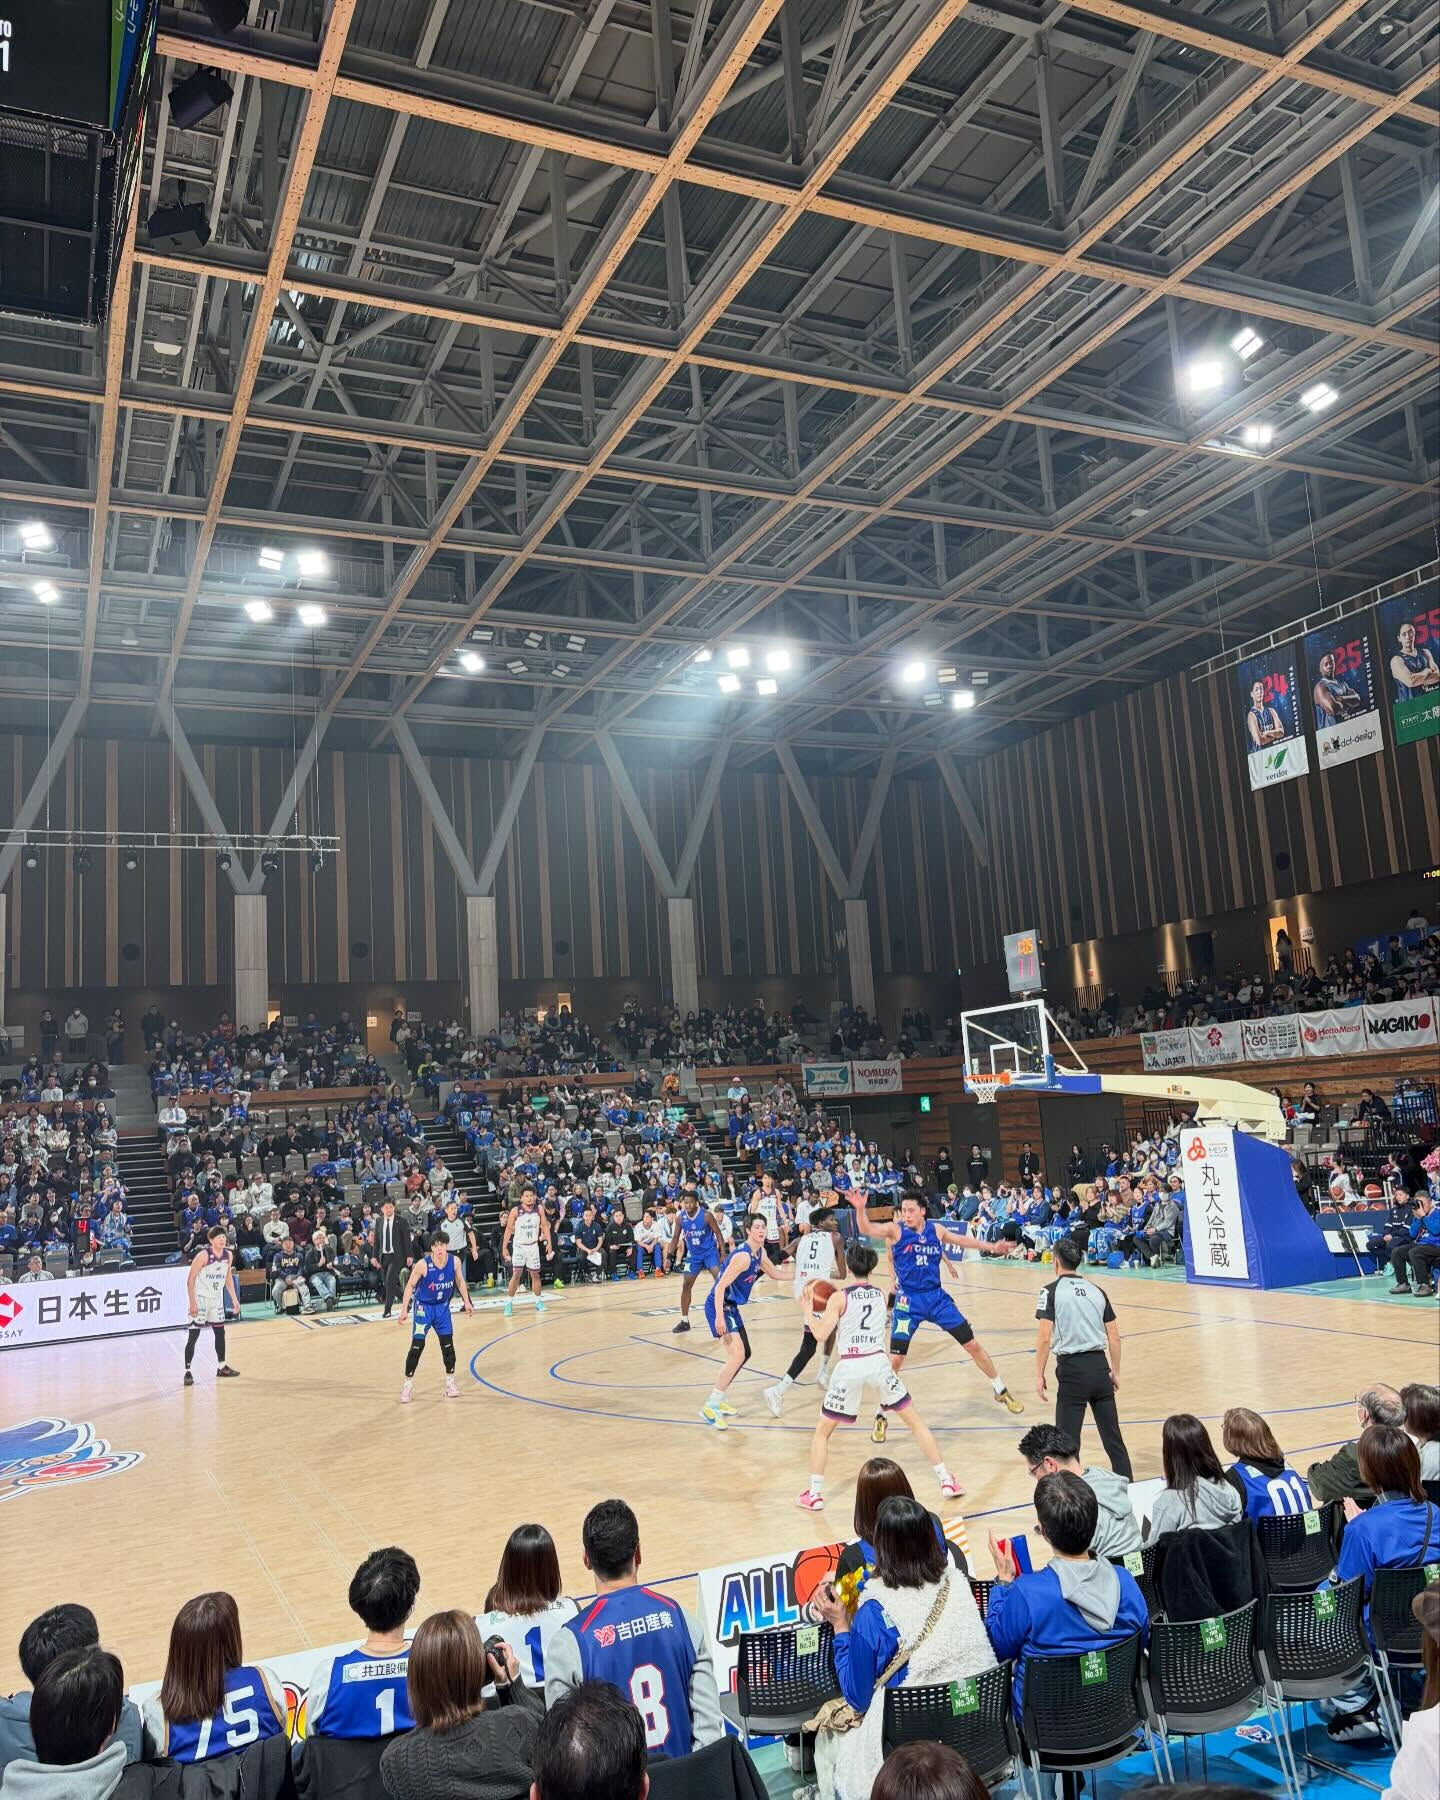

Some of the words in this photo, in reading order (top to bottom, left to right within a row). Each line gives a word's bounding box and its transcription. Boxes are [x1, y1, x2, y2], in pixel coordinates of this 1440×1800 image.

[1333, 639, 1361, 675] 25
[1263, 672, 1288, 703] 24
[1245, 1024, 1266, 1036] RIN
[857, 1068, 898, 1078] NOMURA
[1200, 1162, 1230, 1268] 丸大冷蔵
[38, 1286, 163, 1325] 日本生命
[860, 1304, 872, 1331] 2
[717, 1563, 800, 1646] ALL
[615, 1610, 674, 1641] 吉田産業
[524, 1625, 546, 1684] 1
[1084, 1667, 1103, 1680] No.37
[375, 1687, 396, 1736] 1
[629, 1663, 671, 1749] 8
